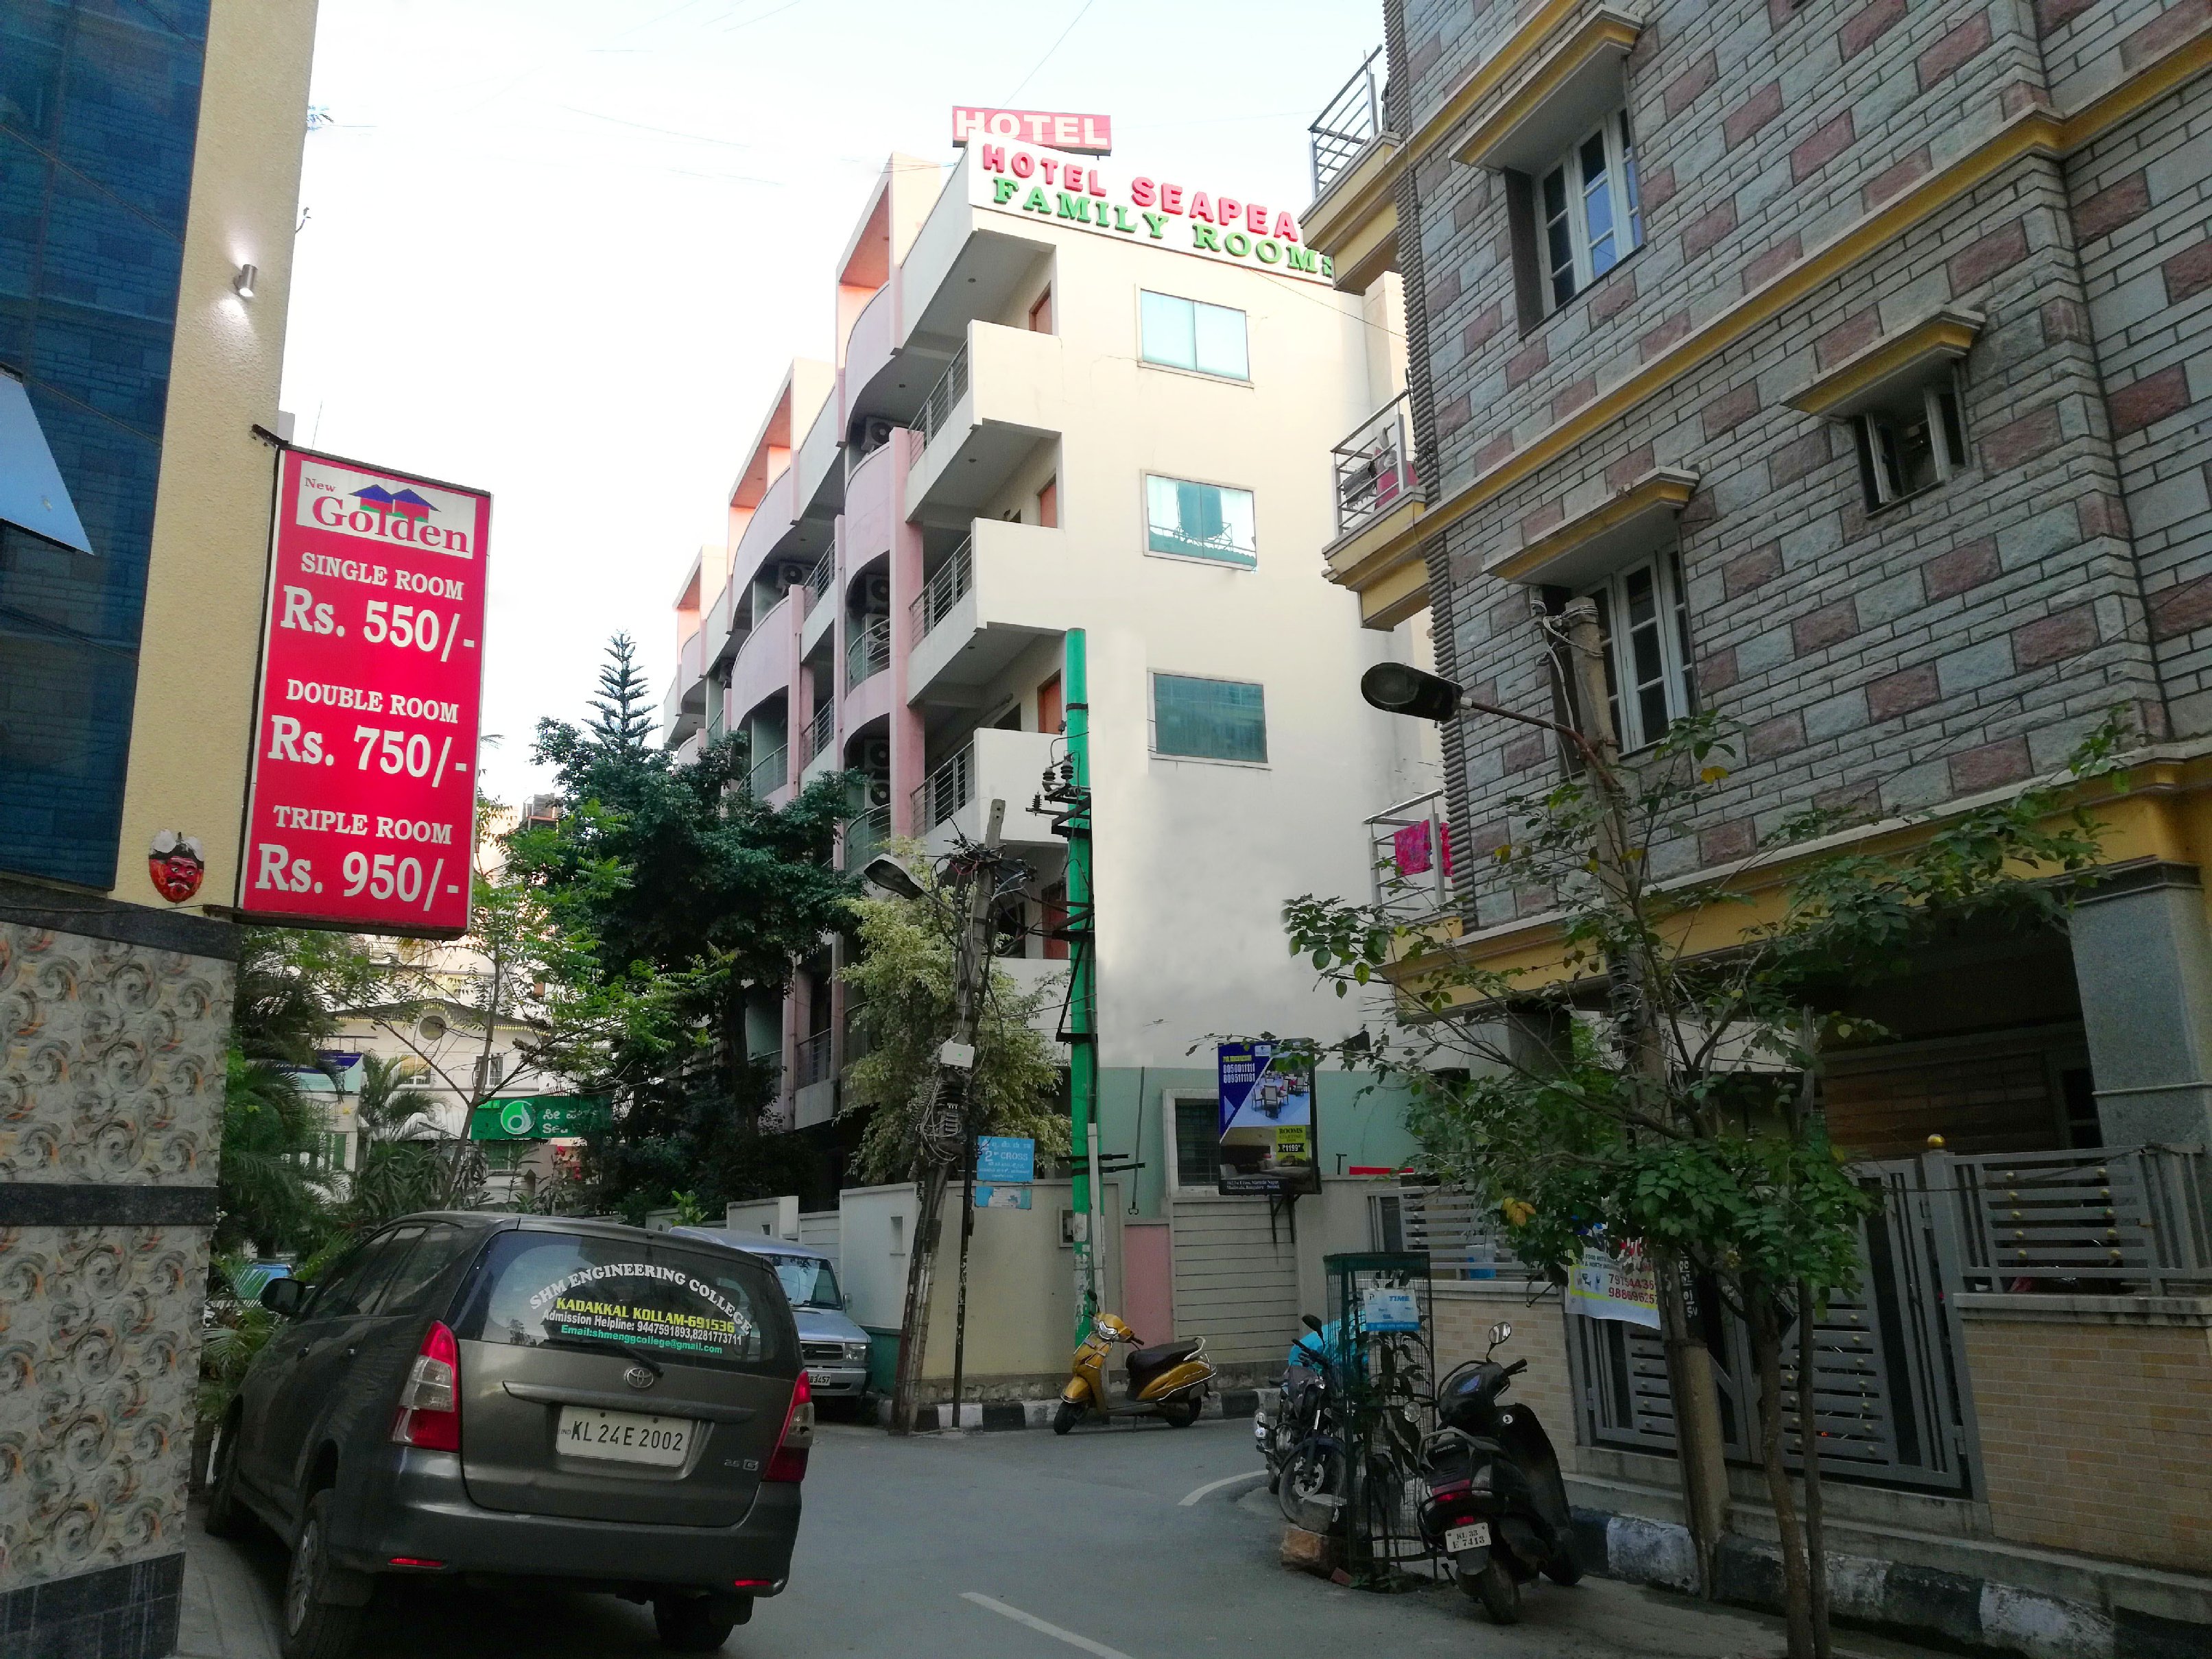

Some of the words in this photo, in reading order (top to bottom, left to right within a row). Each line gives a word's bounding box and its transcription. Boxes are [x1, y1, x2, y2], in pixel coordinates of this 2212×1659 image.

[955, 110, 1108, 146] HOTEL
[983, 143, 1106, 197] HOTEL
[993, 176, 1169, 239] FAMILY
[305, 477, 336, 492] New
[313, 495, 469, 553] Golden
[301, 552, 388, 587] SINGLE
[395, 569, 464, 601] ROOM
[281, 585, 345, 636] Rs.
[364, 601, 475, 663] 550/-
[287, 679, 383, 713] DOUBLE
[390, 695, 458, 724] ROOM
[267, 715, 334, 767] Rs.
[354, 725, 467, 787] 750/-
[274, 806, 368, 836] TRIPLE
[376, 817, 453, 845] ROOM
[254, 843, 323, 894] Rs.
[342, 852, 459, 912] 950/-
[1279, 1126, 1303, 1134] ROOMS
[1001, 1151, 1028, 1161] CROSS
[530, 1279, 567, 1309] SHM
[569, 1263, 687, 1287] ENGINEERING
[689, 1278, 752, 1335] COLLEGE
[542, 1309, 592, 1326] Admission
[594, 1315, 634, 1331] Helpline:
[556, 1298, 629, 1318] KADAKKAL
[633, 1307, 735, 1333] KOLLAM-691536
